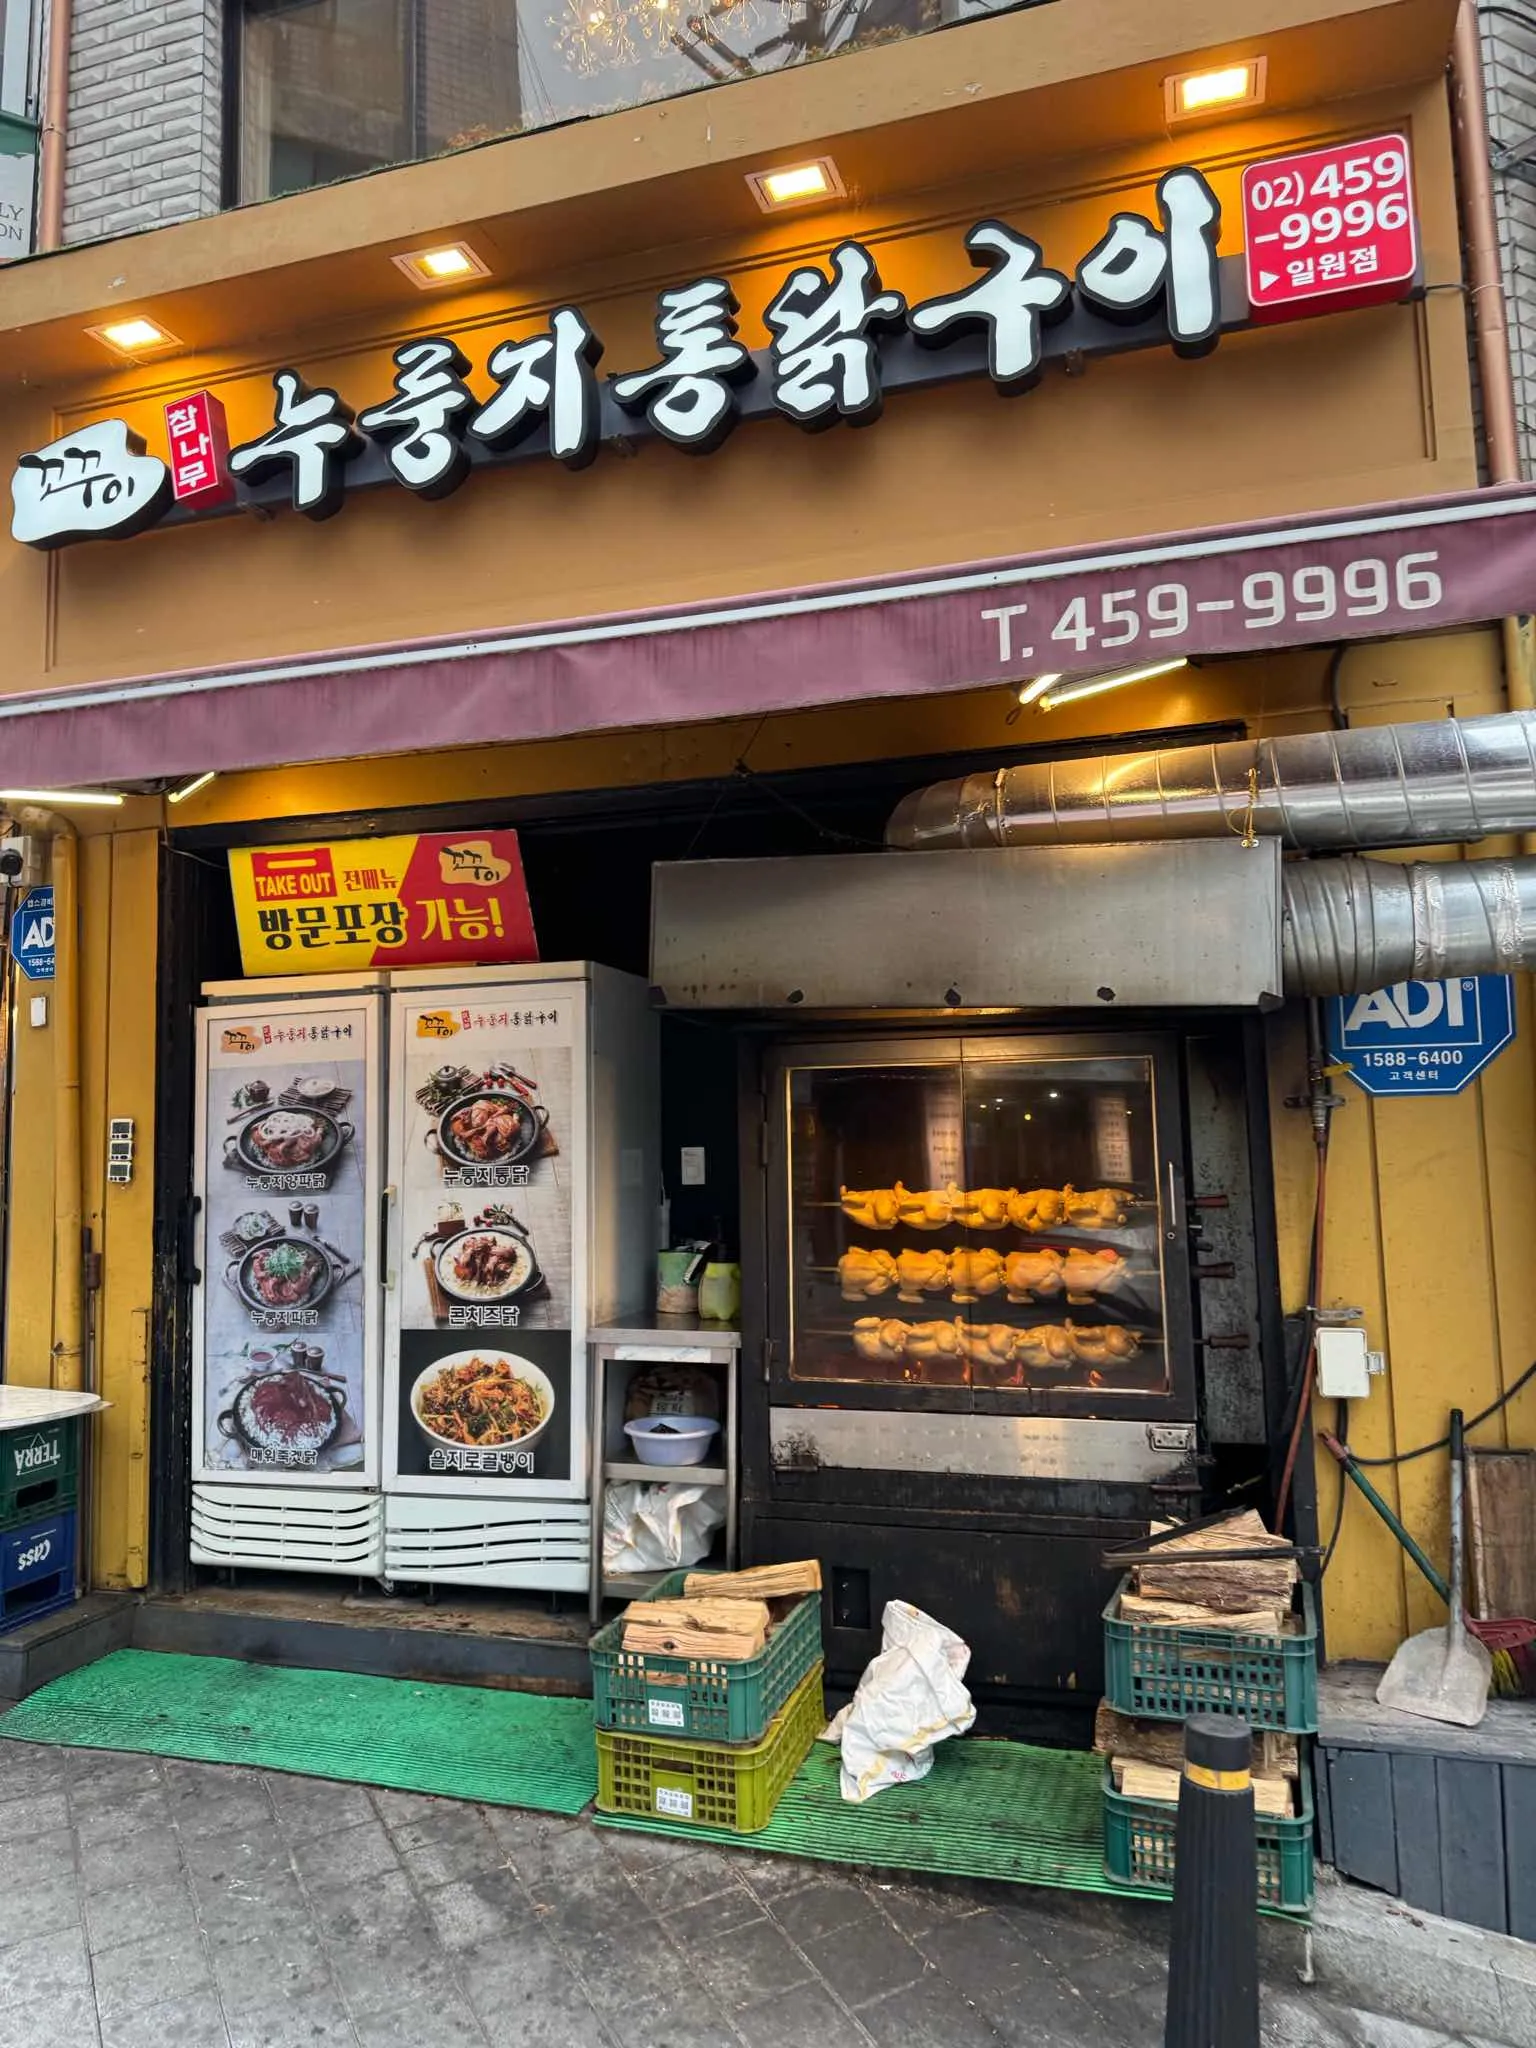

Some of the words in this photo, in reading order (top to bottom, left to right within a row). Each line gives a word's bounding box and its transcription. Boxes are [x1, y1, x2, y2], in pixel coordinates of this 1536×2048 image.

[1252, 171, 1304, 211] 02)
[1310, 151, 1404, 199] 459
[1255, 193, 1407, 250] -9996
[1286, 245, 1378, 287] 일원점
[168, 404, 214, 490] 참나무
[982, 606, 1033, 662] T.
[1050, 552, 1444, 653] 459-9996
[256, 874, 297, 897] TAKE
[301, 872, 332, 895] OUT
[343, 869, 399, 891] 전메뉴
[22, 917, 55, 950] AD
[258, 902, 405, 950] 방문포장
[416, 897, 504, 942] 가능!
[1363, 1050, 1463, 1067] 1588-6400
[1388, 1070, 1440, 1081] 고객센터
[246, 1173, 326, 1191] 누룽지양파닭
[443, 1165, 529, 1187] 누룽지통닭
[449, 1305, 520, 1327] 콘치즈닭
[14, 1439, 61, 1472] TERRA
[429, 1448, 534, 1474] 을지로골뱅이
